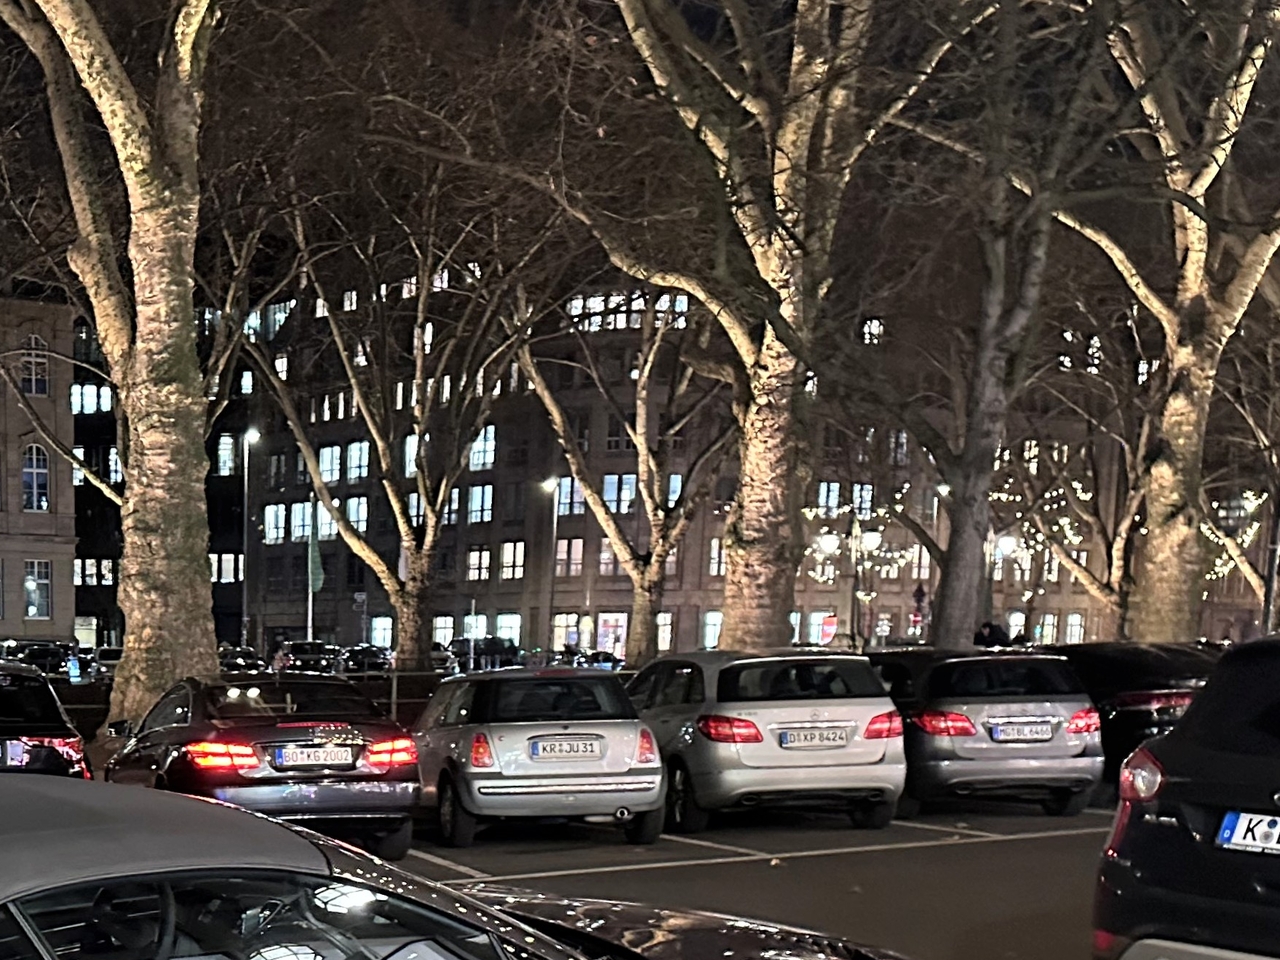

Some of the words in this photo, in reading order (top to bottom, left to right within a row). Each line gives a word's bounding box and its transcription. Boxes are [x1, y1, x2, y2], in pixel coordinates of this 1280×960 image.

[789, 733, 796, 743] D
[803, 732, 816, 742] XP
[818, 731, 845, 742] 8424
[542, 744, 556, 753] KR
[565, 743, 579, 753] JU
[581, 743, 595, 753] 31
[322, 749, 350, 761] 2002
[1243, 818, 1263, 841] K
